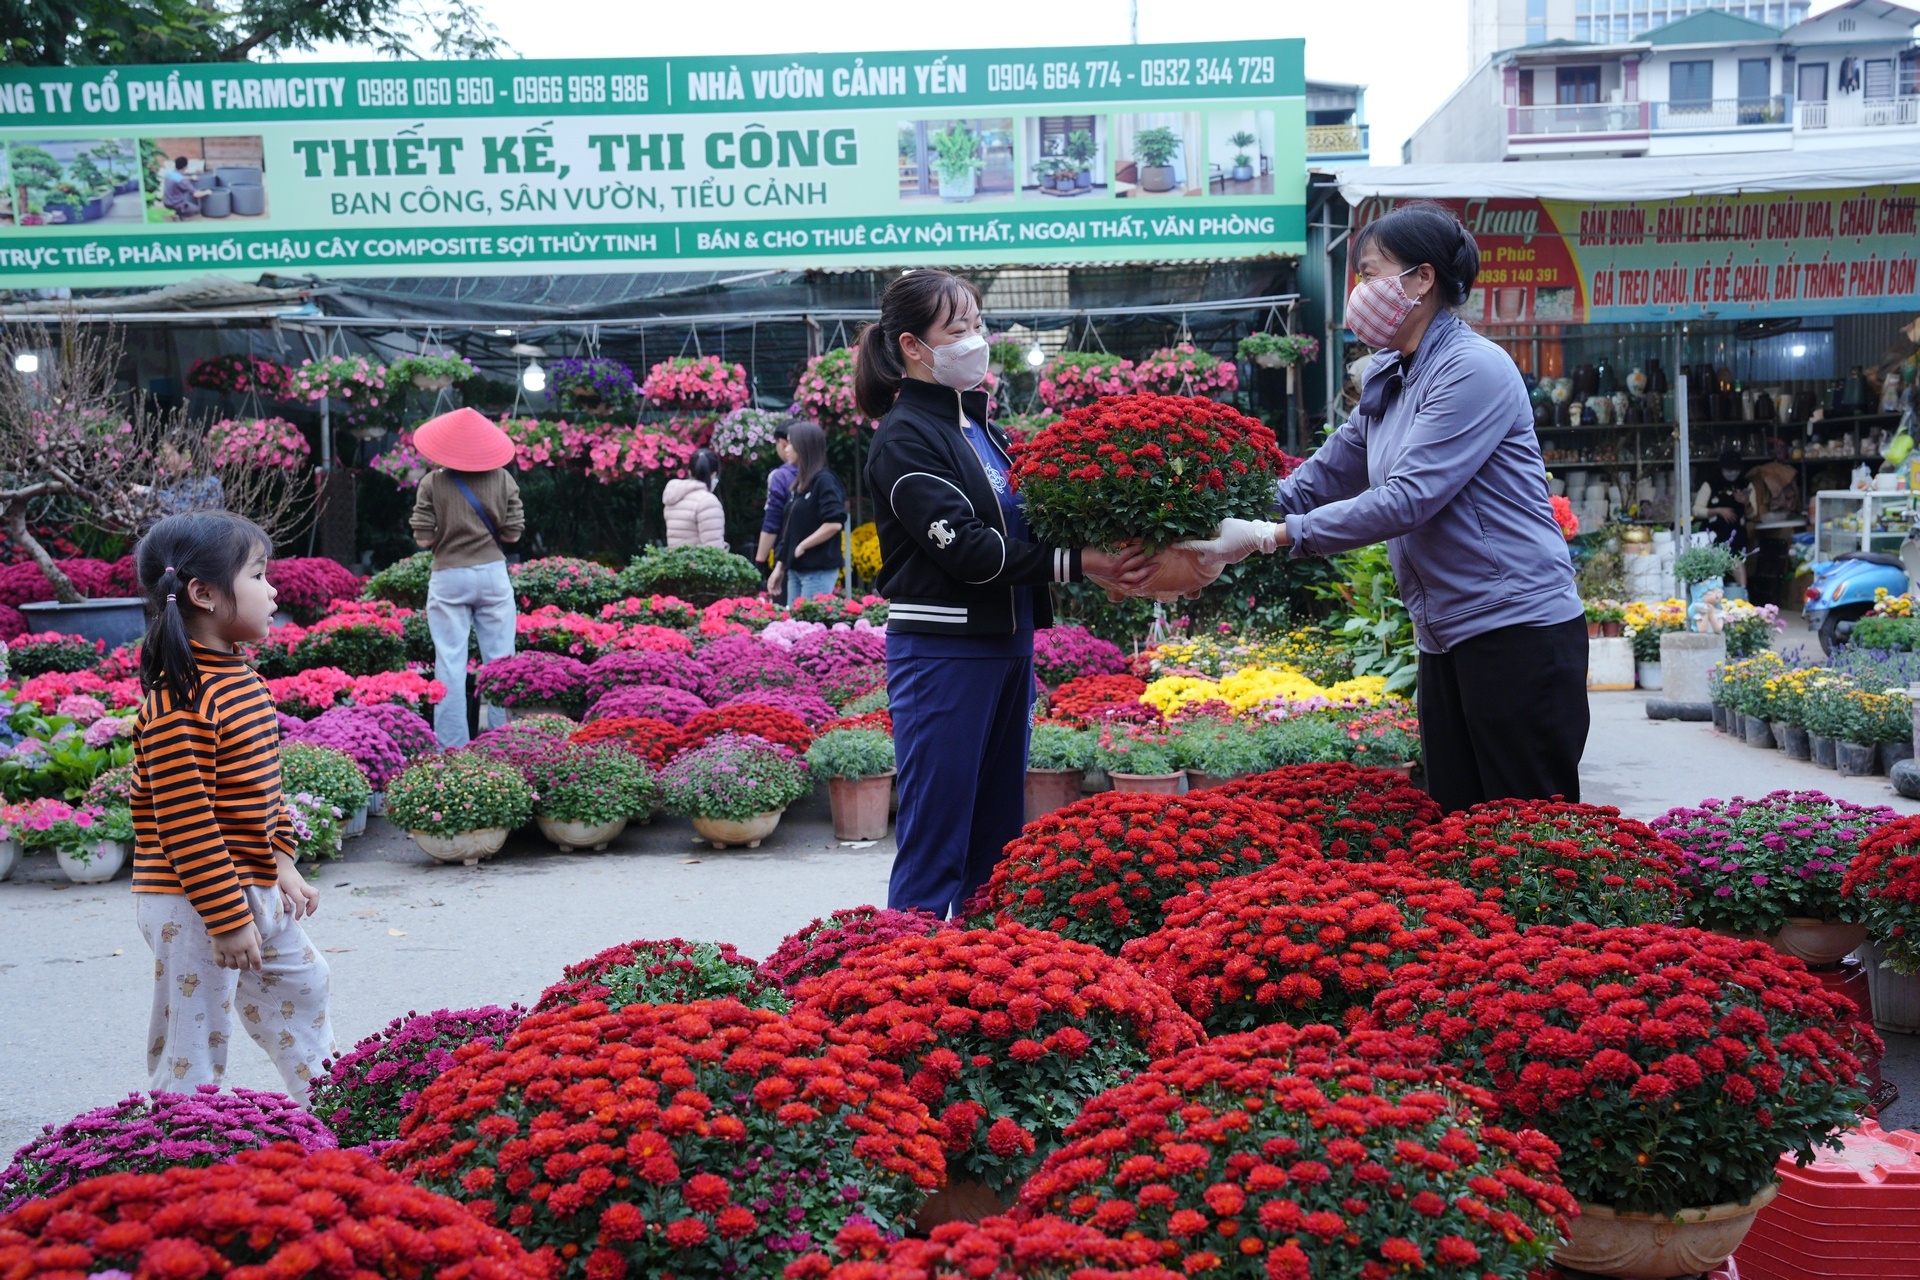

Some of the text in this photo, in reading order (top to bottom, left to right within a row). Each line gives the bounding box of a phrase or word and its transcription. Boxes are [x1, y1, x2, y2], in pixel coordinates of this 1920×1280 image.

[40, 82, 73, 113] TY
[81, 69, 121, 113] CỔ
[127, 70, 205, 112] PHẦN
[210, 77, 346, 110] FARMCITY
[357, 78, 408, 106] 0988
[413, 77, 451, 105] 060
[456, 76, 495, 105] 960
[513, 76, 563, 104] 0966
[568, 75, 606, 103] 968
[611, 74, 649, 102] 986
[688, 65, 745, 101] NHÀ
[751, 62, 824, 99] VƯỜN
[832, 58, 906, 97] CẢNH
[913, 55, 967, 94] YẾN
[987, 63, 1038, 91] 0904
[1043, 62, 1081, 90] 664
[1085, 60, 1122, 88] 774
[1141, 58, 1190, 87] 0932
[1196, 57, 1233, 85] 344
[1238, 56, 1275, 84] 729
[293, 120, 858, 181] THIẾT KẾ, THI CÔNG
[331, 176, 828, 216] BAN CÔNG, SÂN VƯỜN, TIỂU CẢNH
[697, 213, 1275, 250] BÁN & CHO THUÊ CÂY NỘI THẤT, NGOẠI THẤT, VĂN PHÒNG
[1579, 201, 1608, 246] BÁN
[1609, 201, 1646, 246] BUÔN
[1656, 200, 1685, 244] BÁN
[1705, 198, 1732, 242] CÁC
[1734, 204, 1765, 249] LOẠI
[1767, 194, 1803, 248] CHẬU
[1804, 201, 1834, 242] HOA,
[1839, 191, 1876, 245] CHẬU
[0, 231, 657, 270] TRỰC TIẾP, PHÂN PHỐI CHẬU CÂY COMPOSITE SỢI THỦY TINH
[1497, 246, 1536, 262] Phúc
[1477, 267, 1559, 284] 0936 140 391
[1593, 263, 1614, 306] GIÁ
[1618, 269, 1650, 305] TREO
[1652, 260, 1689, 312] CHẬU,
[1693, 259, 1711, 310] KỆ
[1733, 258, 1770, 311] CHẬU,
[1774, 251, 1801, 300] ĐẤT
[1848, 253, 1886, 297] PHÂN
[1888, 250, 1917, 295] BÓN
